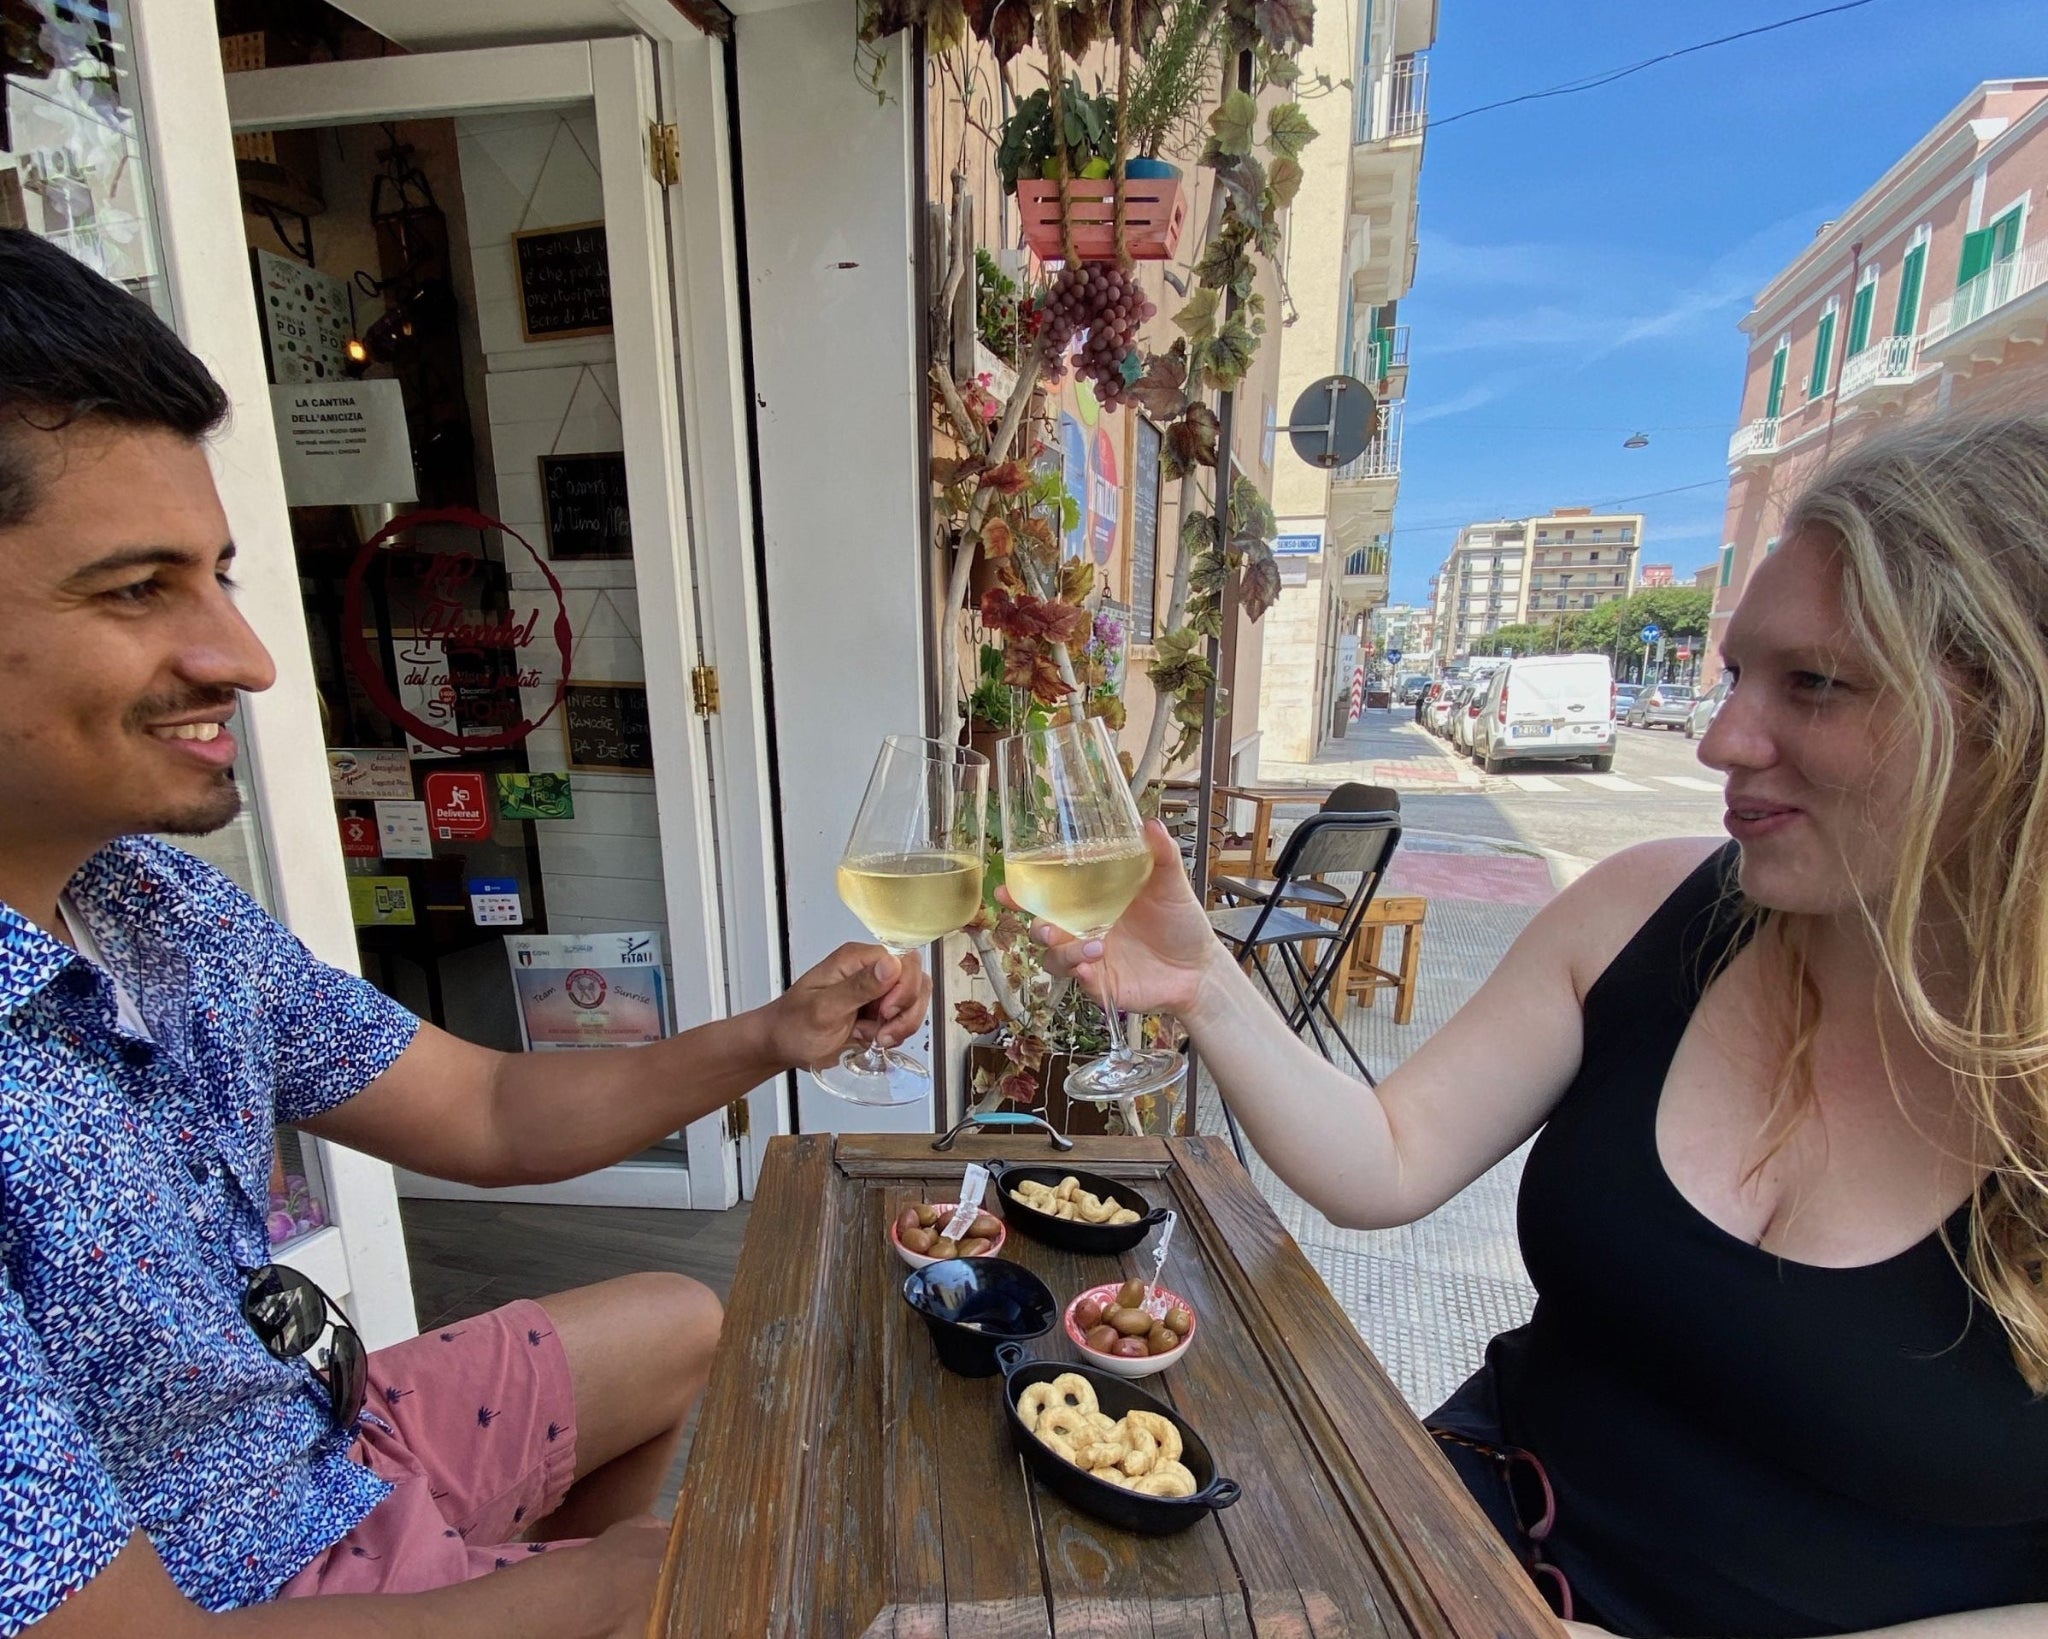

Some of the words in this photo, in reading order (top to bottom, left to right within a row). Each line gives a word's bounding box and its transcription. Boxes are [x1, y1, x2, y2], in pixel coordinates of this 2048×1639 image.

[277, 320, 306, 337] POP
[295, 399, 309, 408] LA
[311, 397, 356, 407] CANTINA
[291, 412, 363, 423] DELL'AMICIZIA
[1297, 540, 1316, 548] UNICO
[404, 666, 429, 685] dal
[567, 694, 608, 709] INVECE
[573, 738, 592, 753] DA
[436, 808, 480, 818] Delivereat
[533, 987, 557, 1004] Team
[613, 985, 651, 1005] Sunrise
